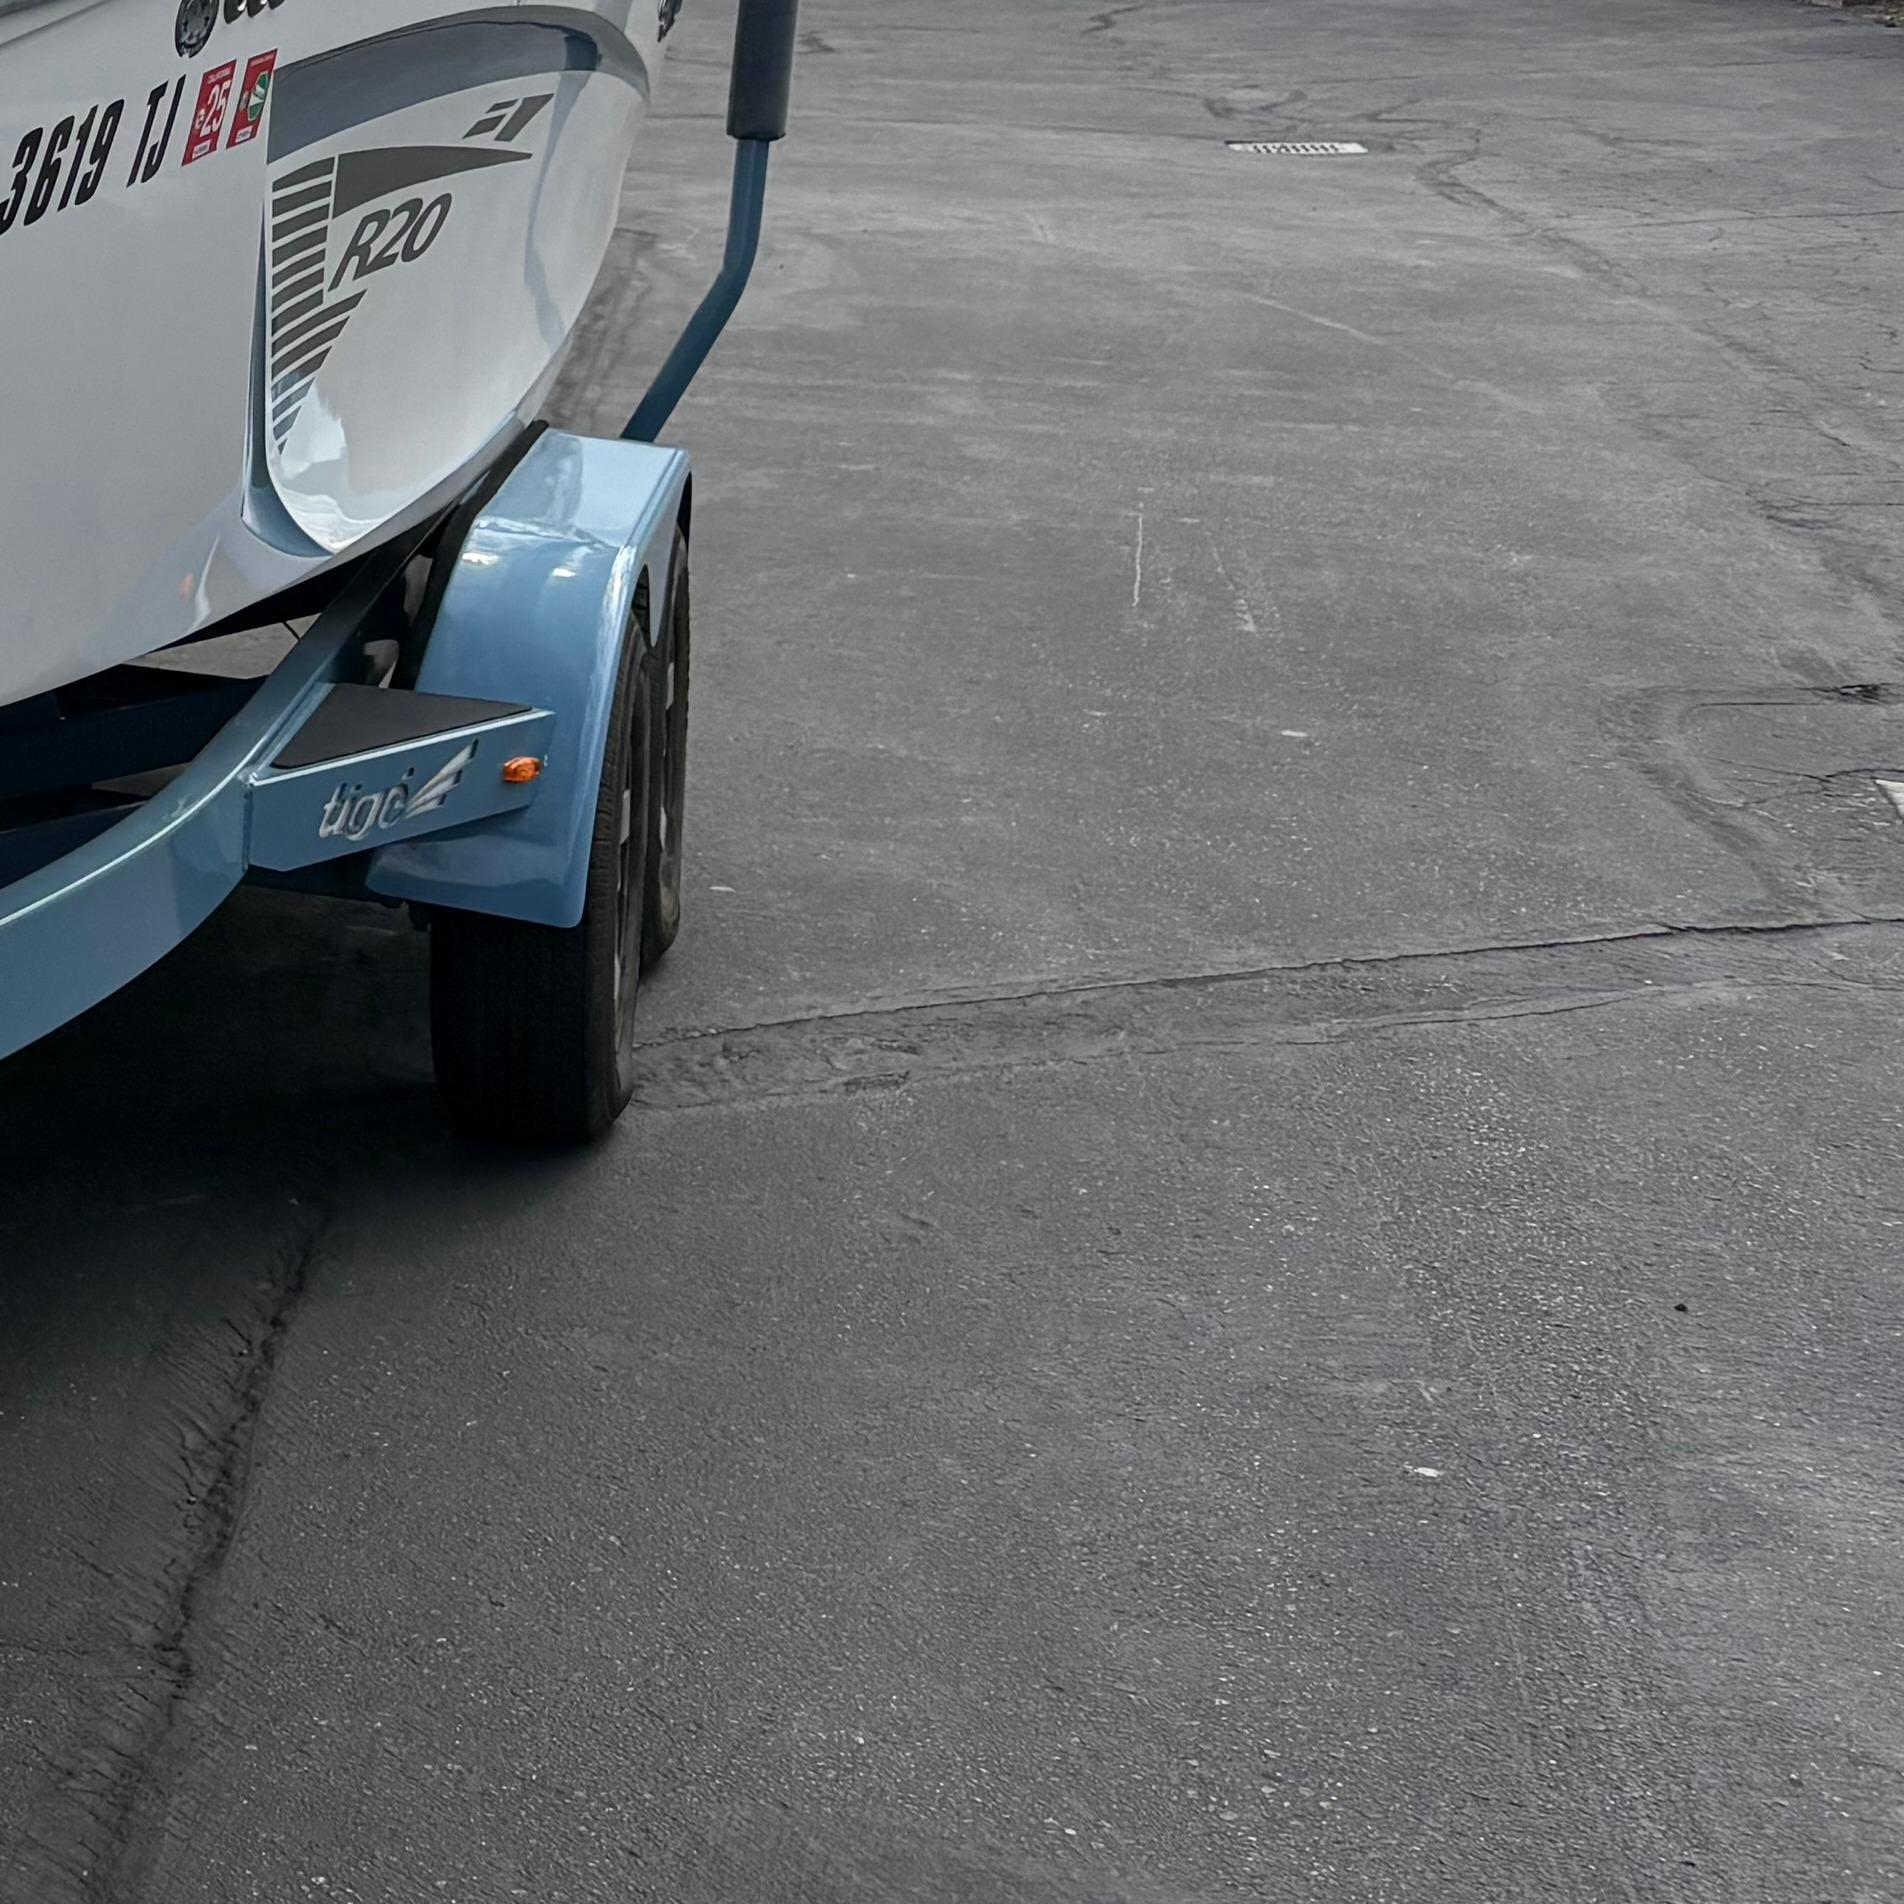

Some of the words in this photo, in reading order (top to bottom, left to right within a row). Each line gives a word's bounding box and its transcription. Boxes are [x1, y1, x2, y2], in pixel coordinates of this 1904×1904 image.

[126, 74, 186, 187] TJ
[199, 79, 232, 138] 25
[327, 192, 453, 292] R20
